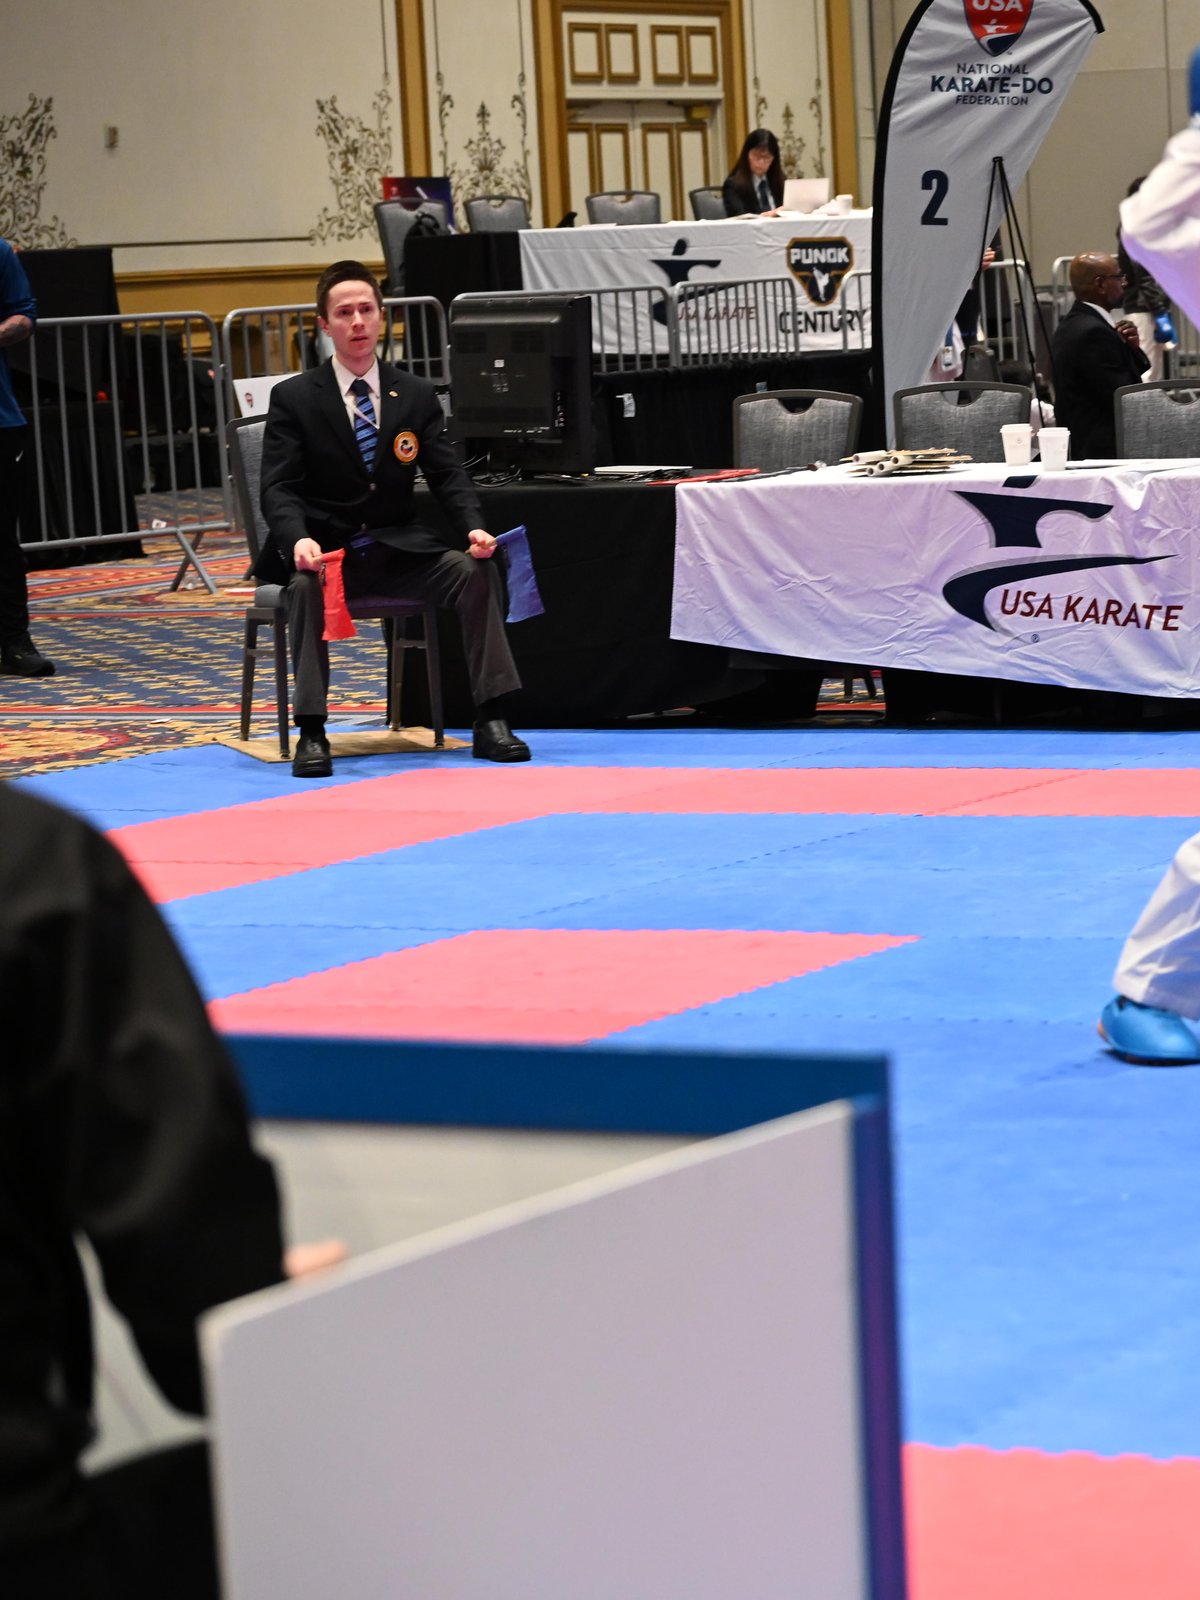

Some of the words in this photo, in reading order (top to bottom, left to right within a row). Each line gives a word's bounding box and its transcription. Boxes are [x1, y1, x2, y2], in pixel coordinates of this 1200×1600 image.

[972, 0, 1023, 12] USA
[956, 63, 1029, 75] NATIONAL
[930, 75, 1053, 94] KARATE-DO
[955, 95, 1028, 106] FEDERATION
[920, 169, 949, 226] 2
[1000, 589, 1054, 619] USA
[1063, 595, 1184, 631] KARATE
